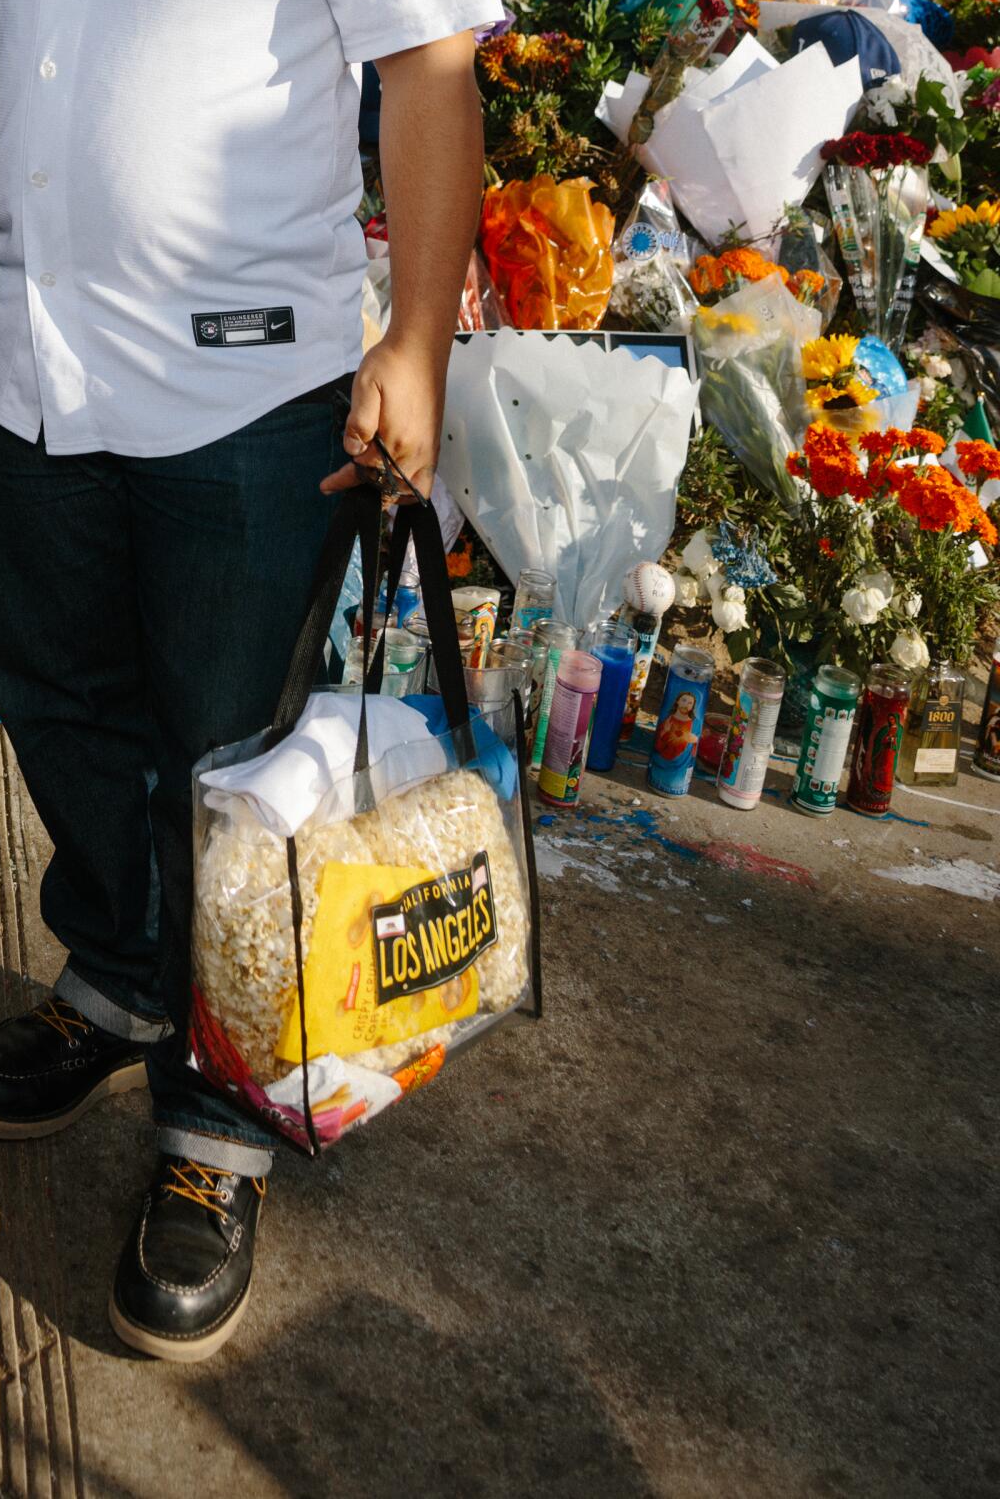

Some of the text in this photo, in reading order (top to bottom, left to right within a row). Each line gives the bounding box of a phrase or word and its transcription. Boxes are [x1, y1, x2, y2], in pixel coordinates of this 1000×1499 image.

[927, 710, 955, 722] 1800
[402, 874, 471, 914] CALIFORNIA
[379, 931, 421, 988] LOS
[419, 888, 491, 974] ANGELES
